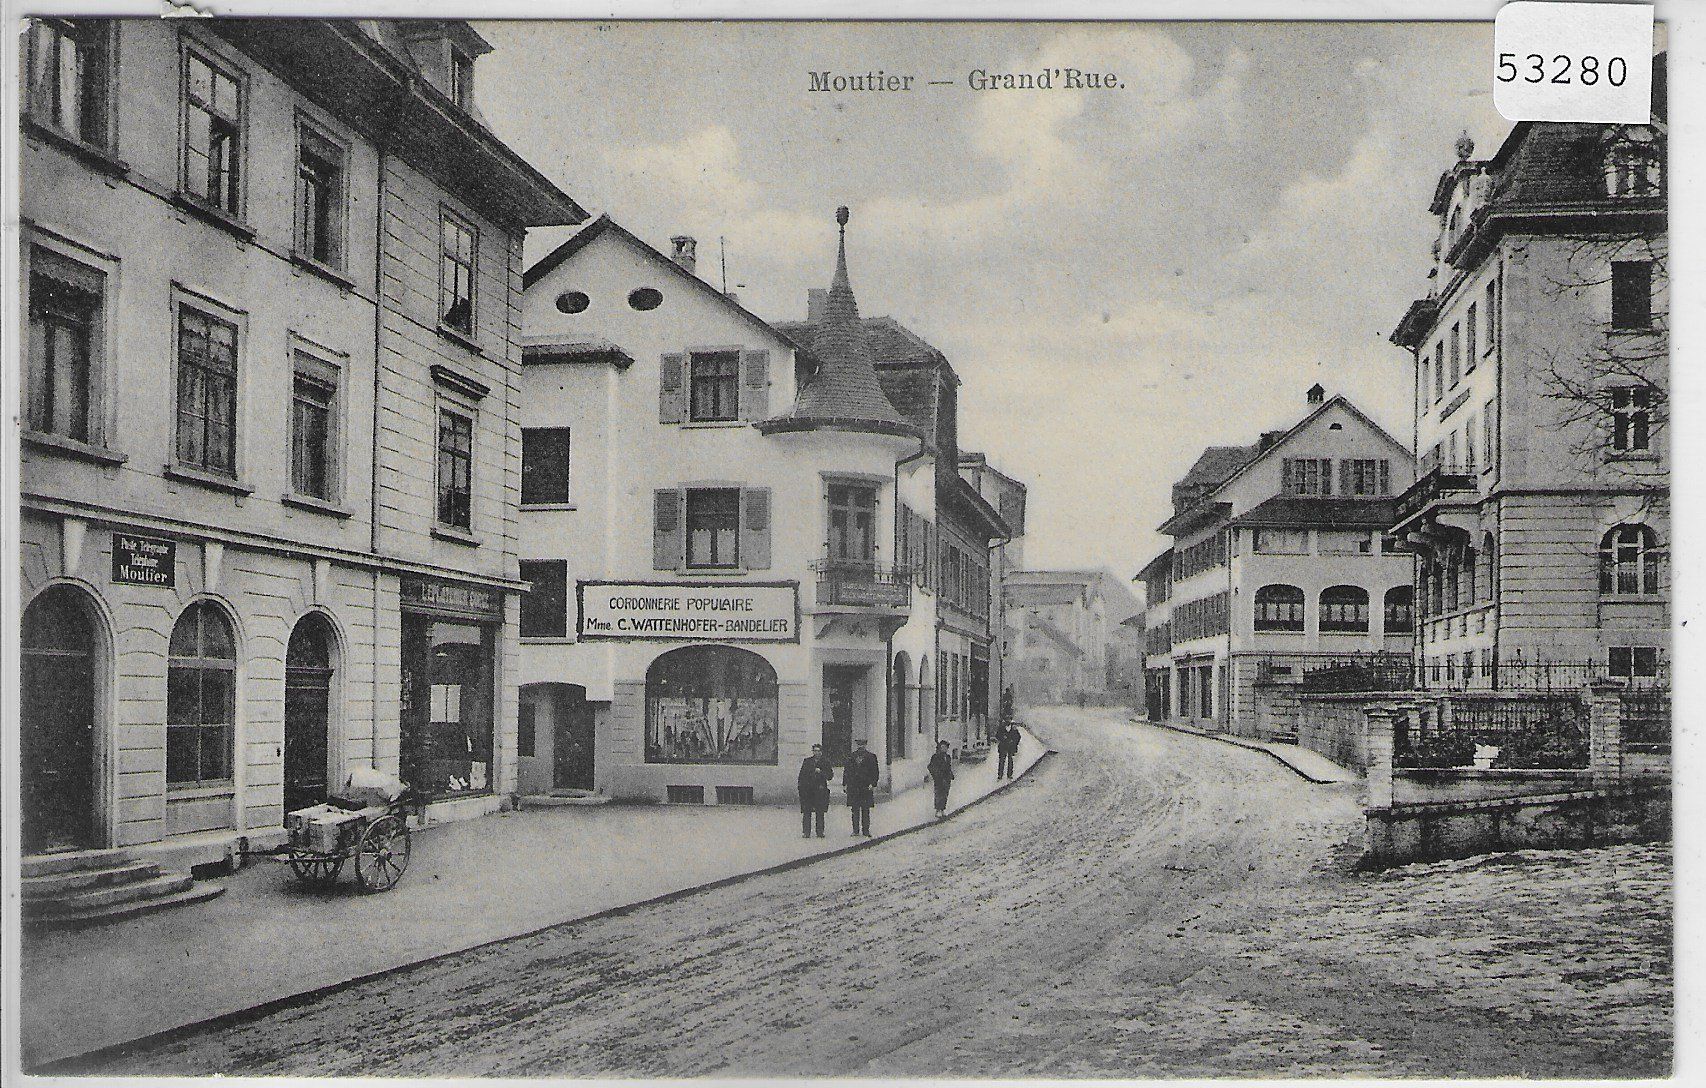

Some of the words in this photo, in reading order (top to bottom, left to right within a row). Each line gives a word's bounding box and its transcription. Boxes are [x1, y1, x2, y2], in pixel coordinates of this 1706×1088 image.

[1496, 53, 1627, 86] 53280
[120, 564, 168, 582] Moutier
[609, 597, 680, 610] CORDONNERIE
[686, 598, 753, 611] POPULAIRE
